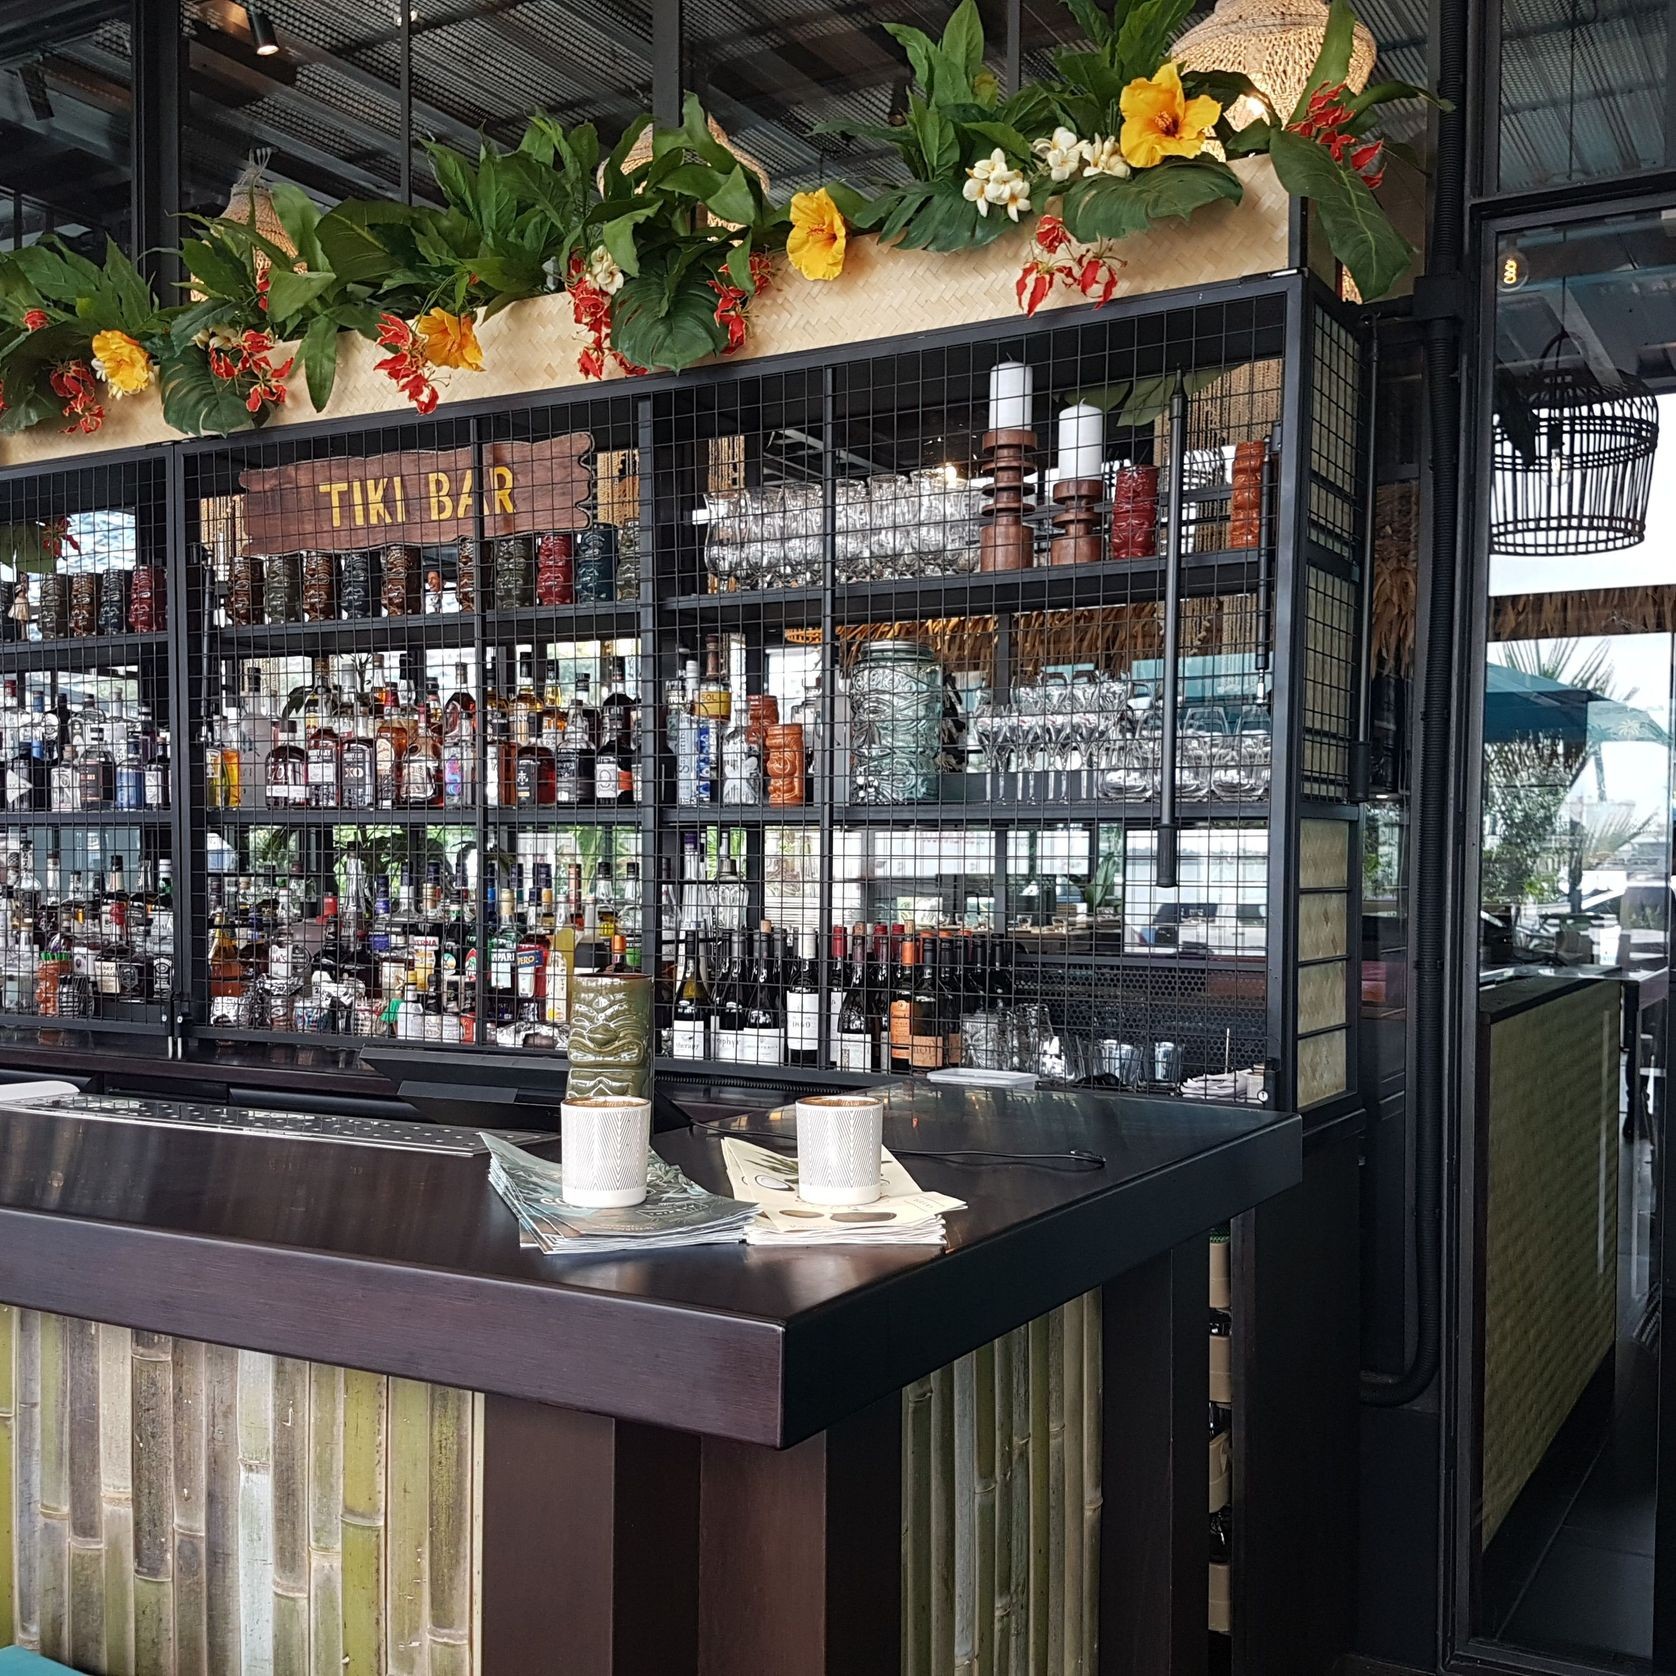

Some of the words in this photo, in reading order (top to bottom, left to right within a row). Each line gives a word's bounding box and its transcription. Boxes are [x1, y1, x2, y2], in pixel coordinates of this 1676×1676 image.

[319, 476, 406, 528] TIKI
[428, 466, 516, 521] BAR
[344, 767, 364, 778] XO
